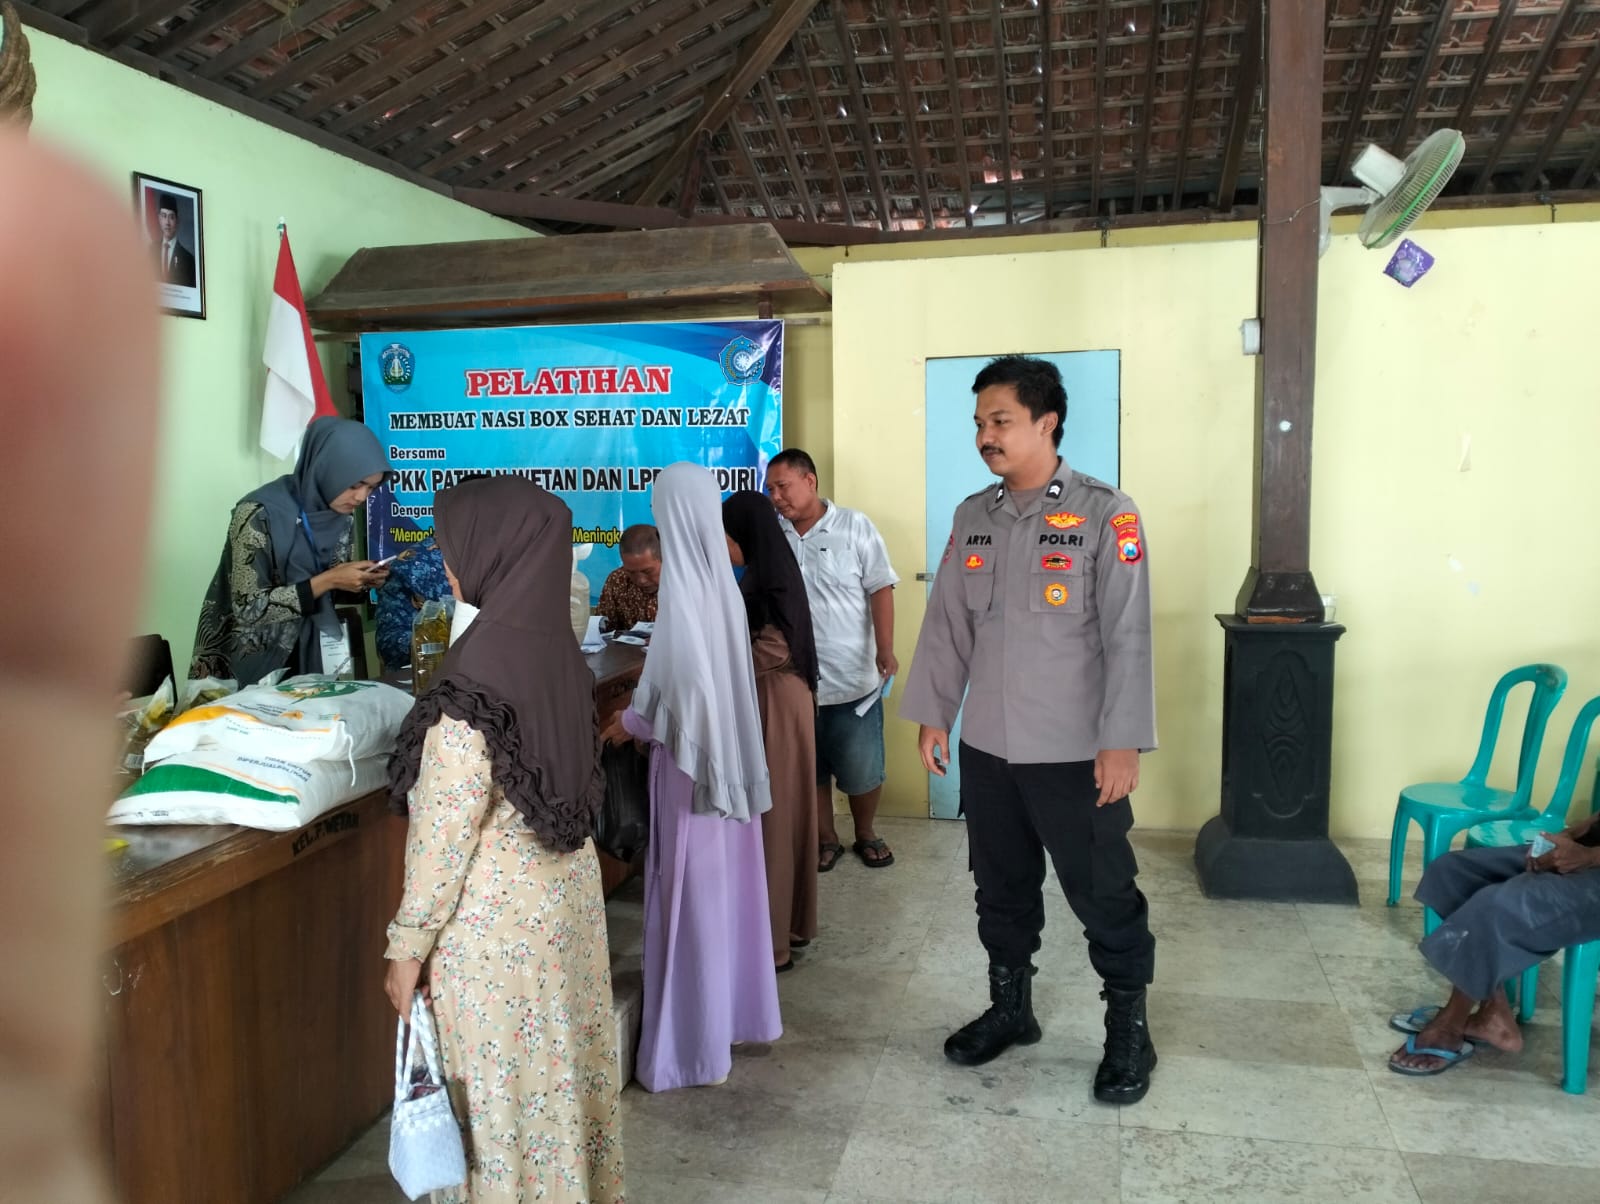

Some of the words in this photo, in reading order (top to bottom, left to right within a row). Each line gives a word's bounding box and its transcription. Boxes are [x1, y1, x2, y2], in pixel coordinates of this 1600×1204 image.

[466, 367, 672, 397] PELATIHAN
[389, 412, 476, 430] MEMBUAT
[481, 411, 526, 428] NASI
[530, 410, 569, 428] BOX
[574, 409, 636, 427] SEHAT
[641, 408, 682, 426] DAN
[687, 408, 749, 426] LEZAT
[389, 446, 445, 460] Bersama
[389, 469, 427, 491] PKK
[582, 468, 622, 491] DAN
[572, 527, 623, 547] Meningk
[966, 534, 992, 546] ARYA
[1038, 534, 1084, 547] POLRI
